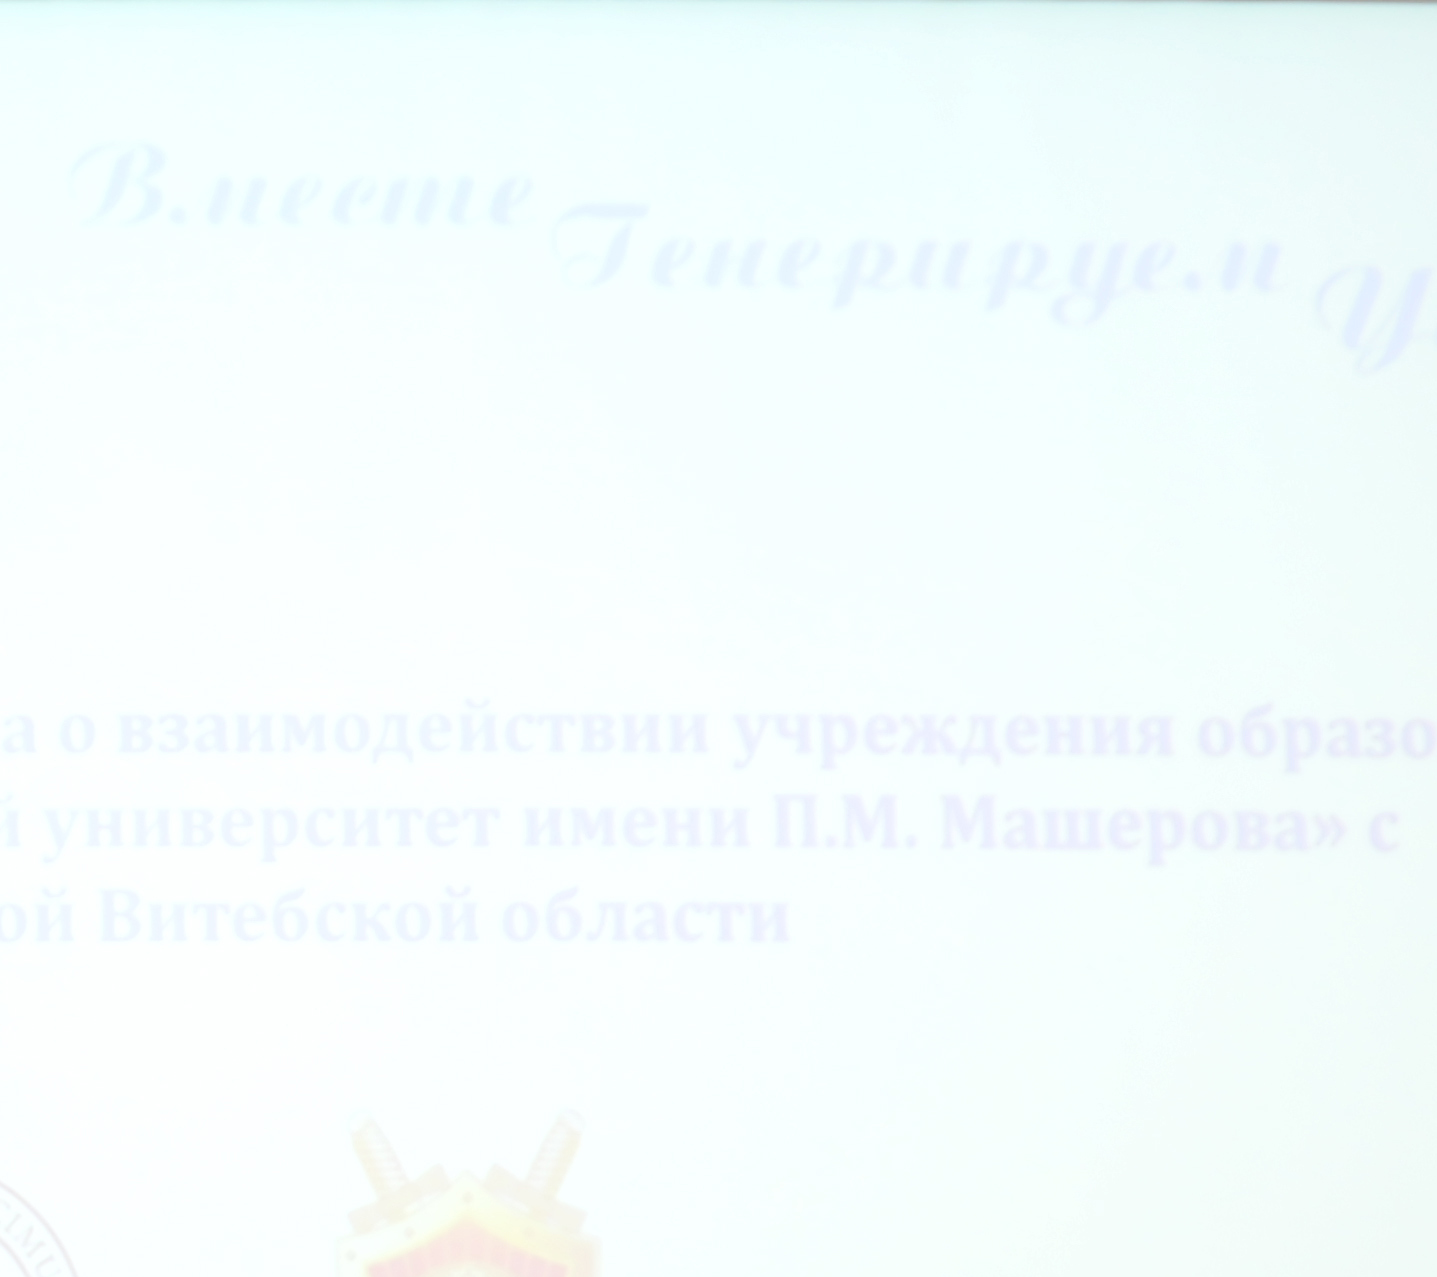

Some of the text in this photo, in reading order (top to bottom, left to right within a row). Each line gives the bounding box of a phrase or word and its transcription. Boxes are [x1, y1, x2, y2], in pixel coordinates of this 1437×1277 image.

[67, 139, 534, 232] Вместе
[551, 200, 1284, 326] Генерируем
[58, 715, 94, 756] о
[118, 697, 710, 768] взаимодействии
[731, 705, 1176, 770] учреждения
[41, 795, 500, 864] университет
[523, 800, 752, 852] имени
[772, 795, 922, 852] П.М.
[939, 797, 1344, 866] Машерова»
[1366, 810, 1402, 858] с
[98, 886, 480, 946] Витебской
[501, 886, 791, 946] области
